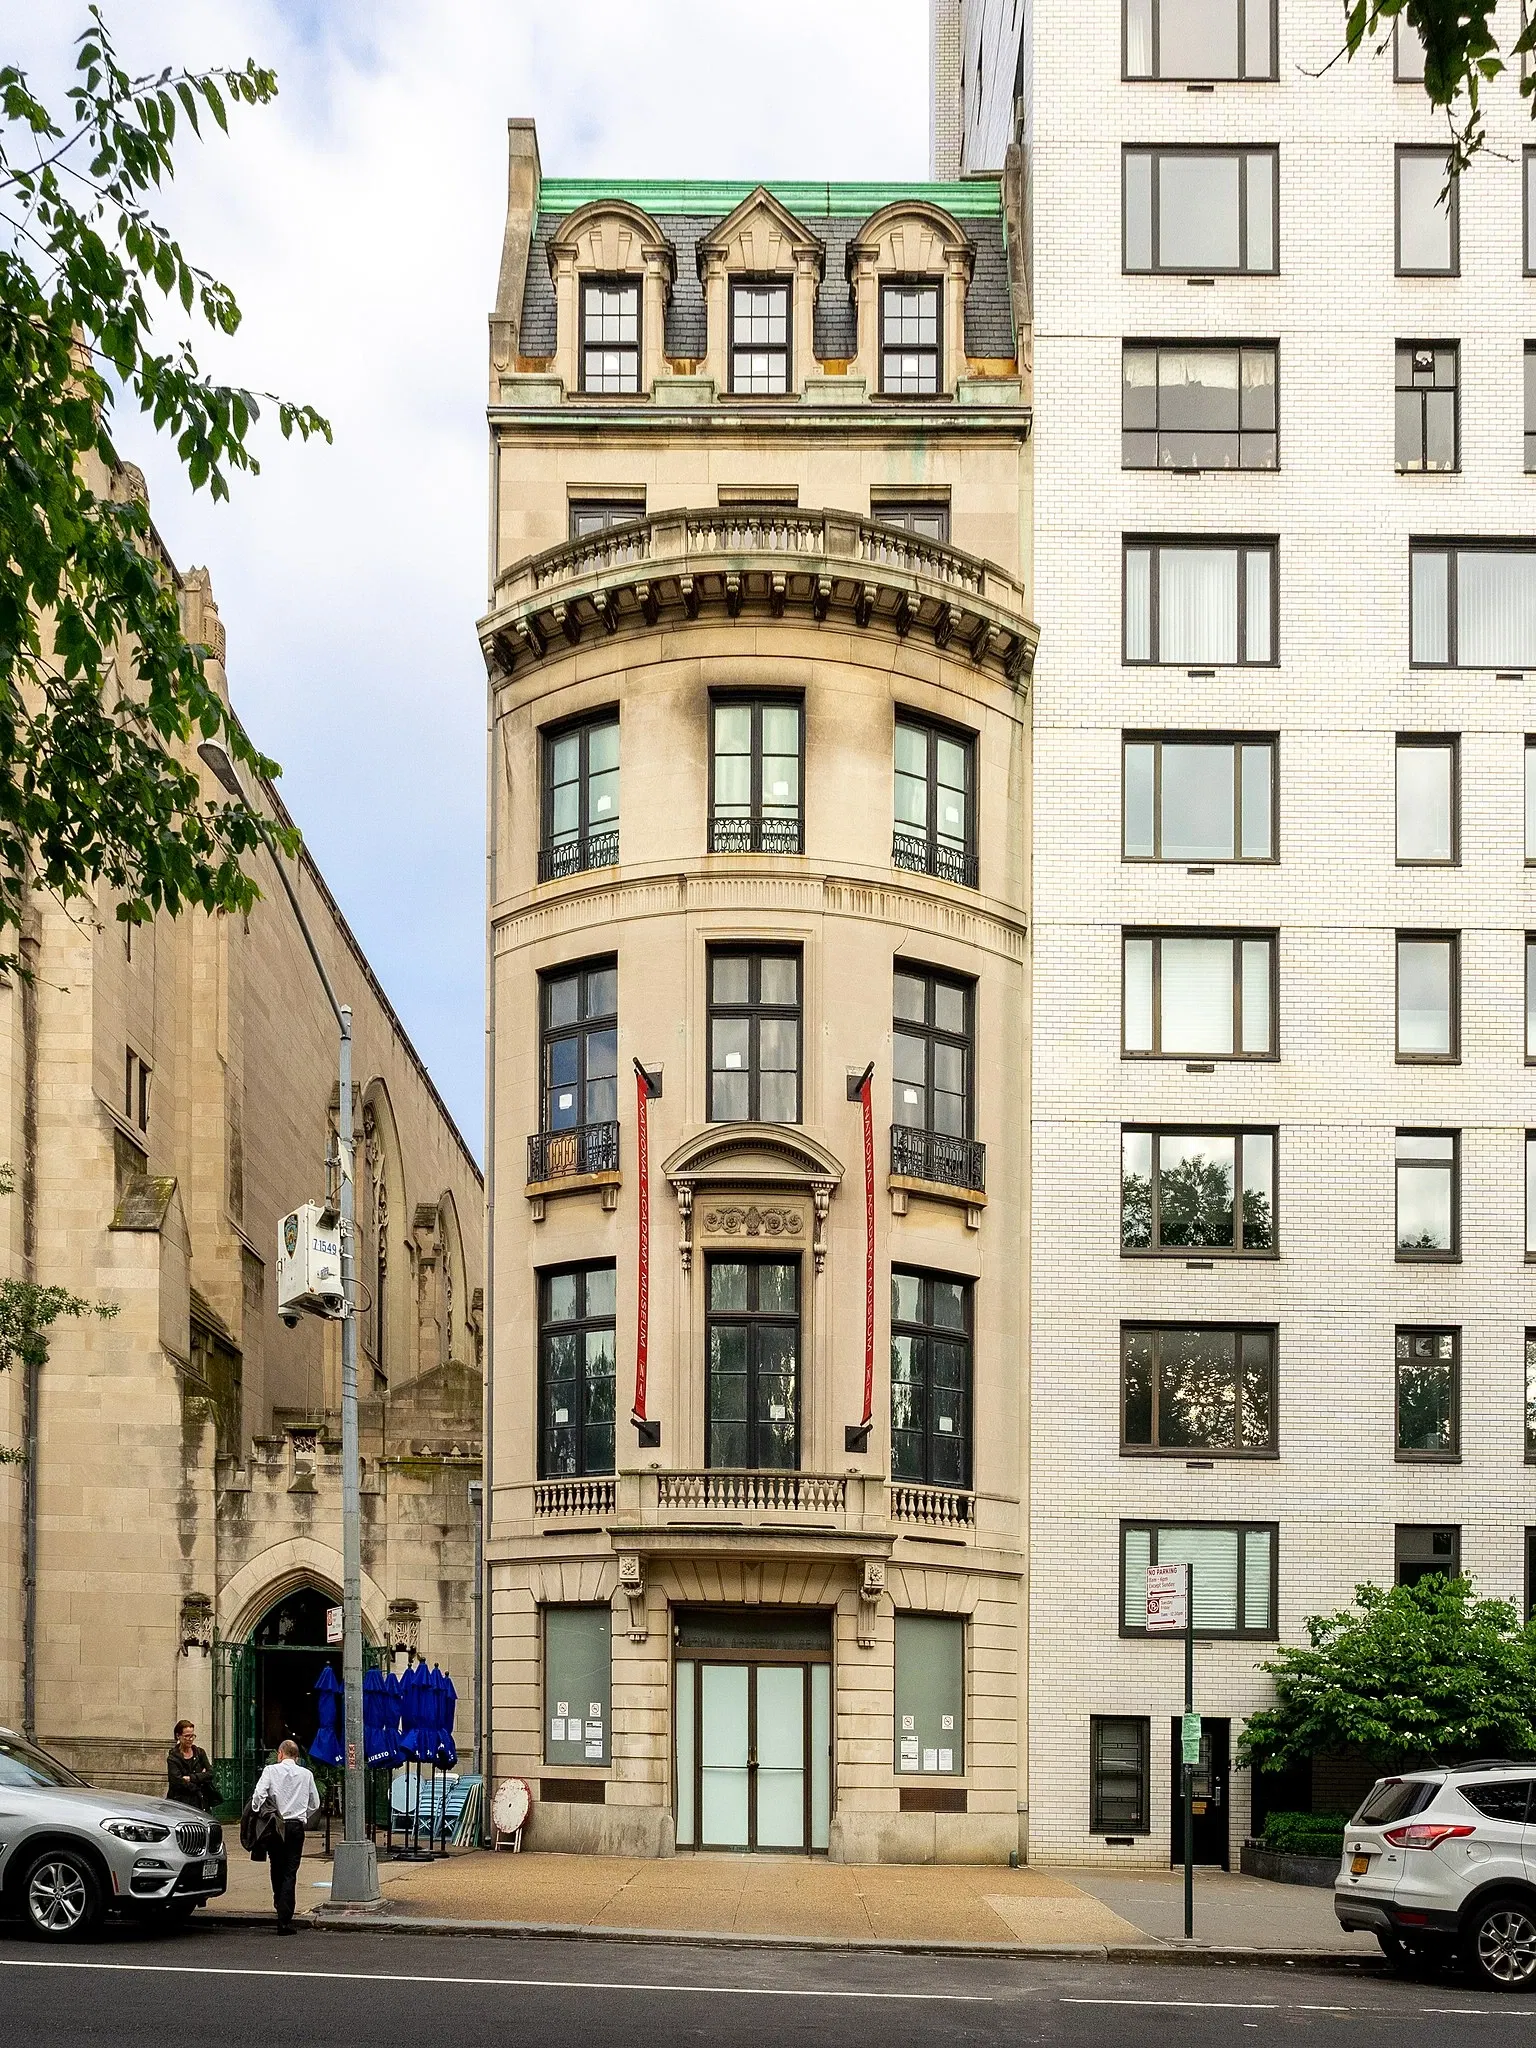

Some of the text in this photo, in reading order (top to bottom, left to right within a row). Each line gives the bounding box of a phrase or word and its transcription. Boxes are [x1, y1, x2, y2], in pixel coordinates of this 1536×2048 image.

[639, 1100, 648, 1181] NATIONAL
[864, 1106, 873, 1189] NATIONAL
[640, 1186, 648, 1269] ACADEMY
[640, 1271, 648, 1348] MUSEUM
[368, 1751, 389, 1763] LUESTO
